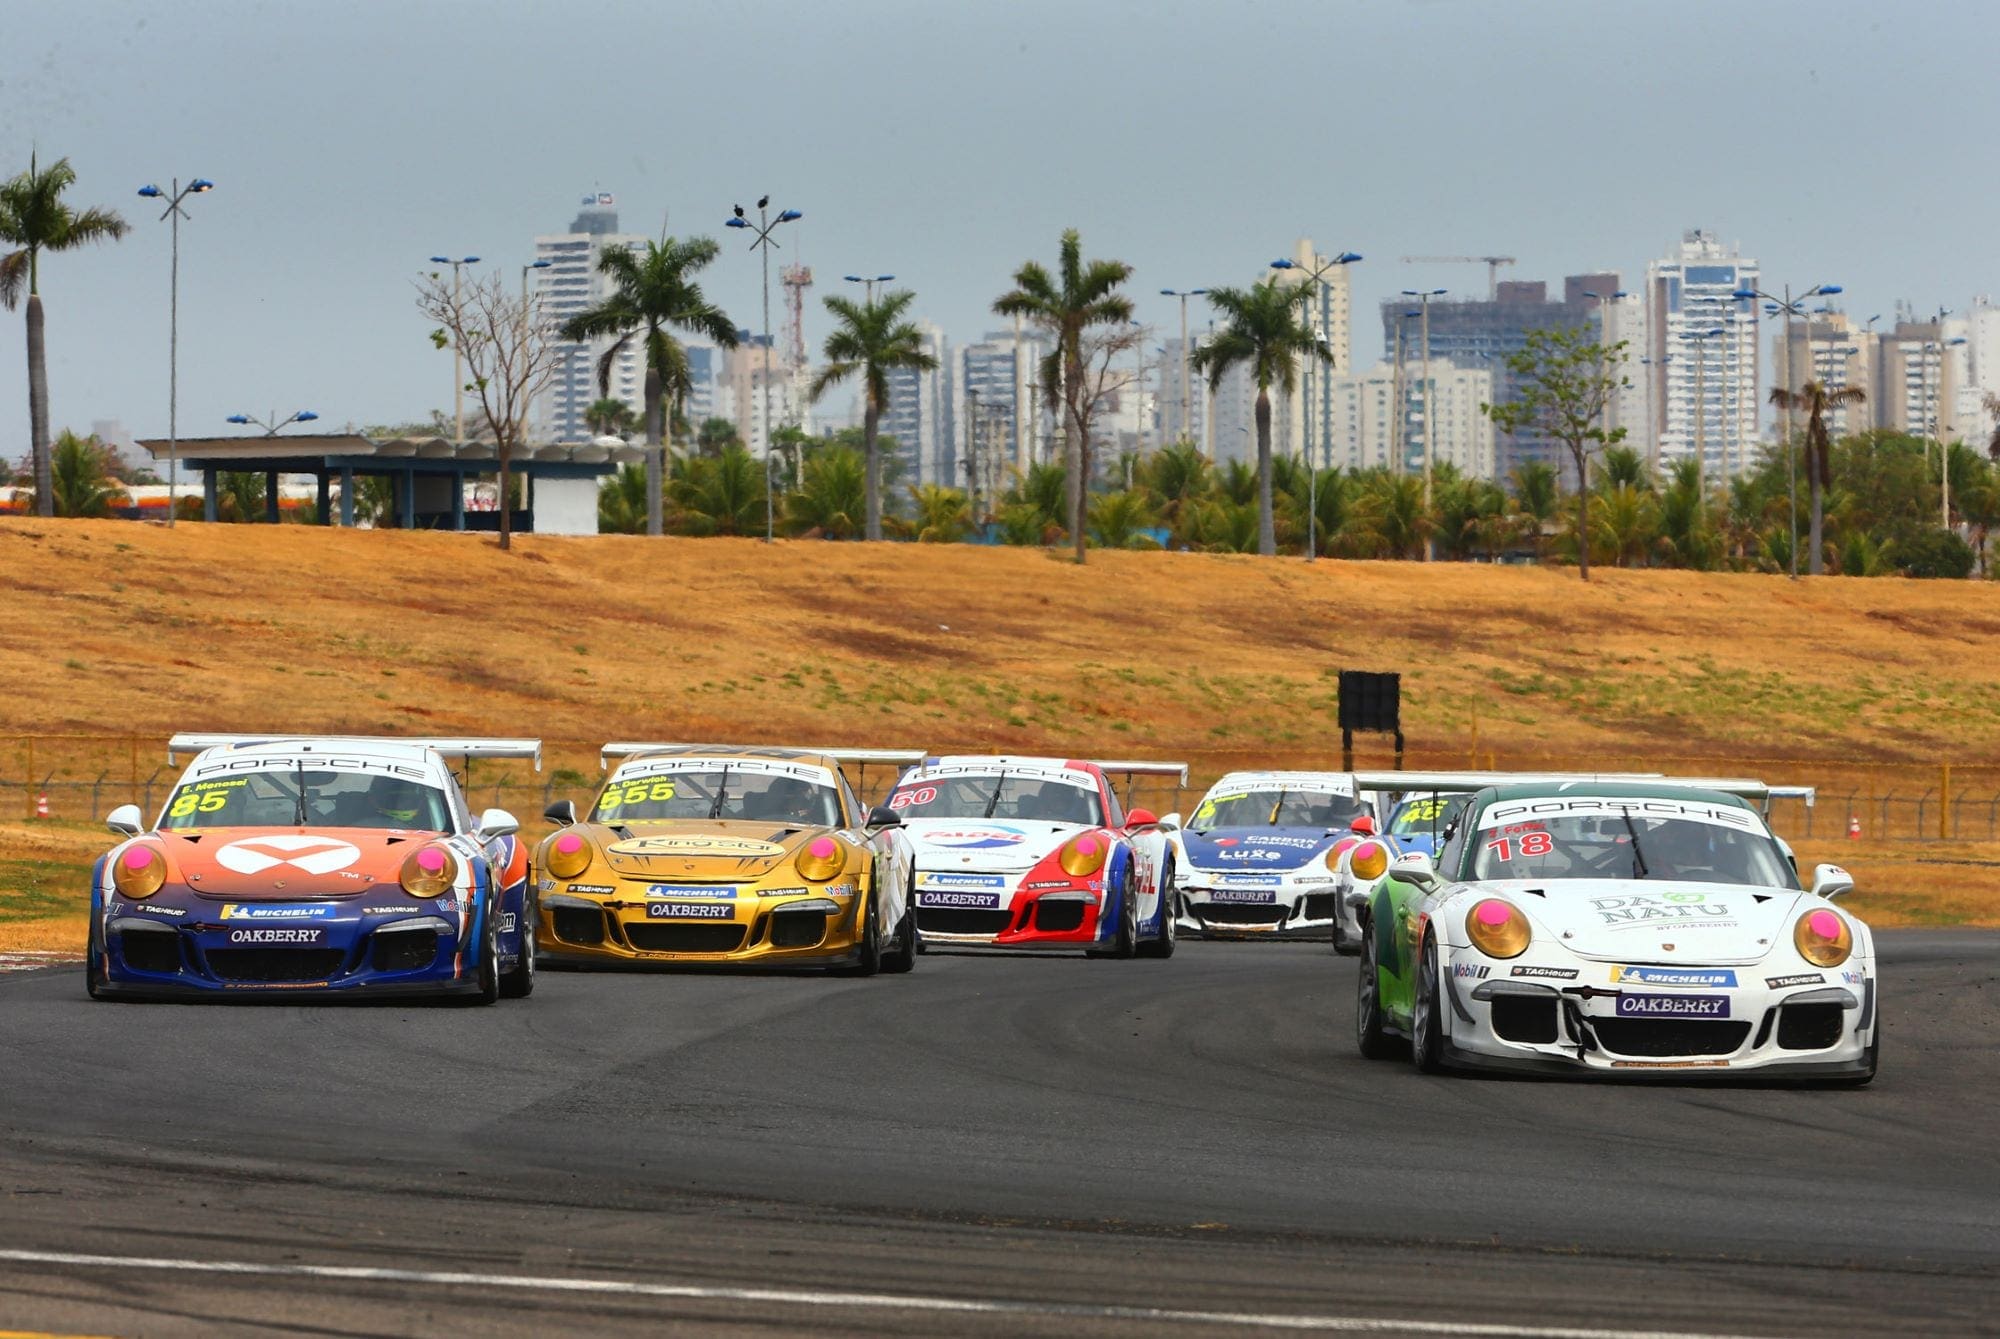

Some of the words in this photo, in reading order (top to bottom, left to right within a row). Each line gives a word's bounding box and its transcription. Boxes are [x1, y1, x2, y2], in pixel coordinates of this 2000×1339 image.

[197, 758, 425, 779] PORSCHE
[622, 761, 820, 779] PORSCHE
[622, 776, 667, 788] Darwich
[914, 767, 1089, 786] PORSCHE
[170, 791, 229, 817] 85
[599, 783, 675, 810] 555
[889, 788, 937, 810] 50
[1494, 801, 1749, 827] PORSCHE
[1487, 831, 1553, 861] 18
[340, 871, 360, 879] TM
[665, 889, 729, 897] MICHELIN
[925, 893, 995, 906] OAKBERRY
[1213, 891, 1271, 902] OAKBERRY
[1589, 895, 1663, 910] DA
[252, 908, 326, 917] MICHELIN
[651, 905, 730, 918] OAKBERRY
[1598, 904, 1729, 923] NATU
[231, 929, 321, 943] OAKBERRY
[1454, 963, 1479, 978] Mobil
[1646, 974, 1726, 984] MICHELIN
[1622, 997, 1725, 1014] OAKBERRY
